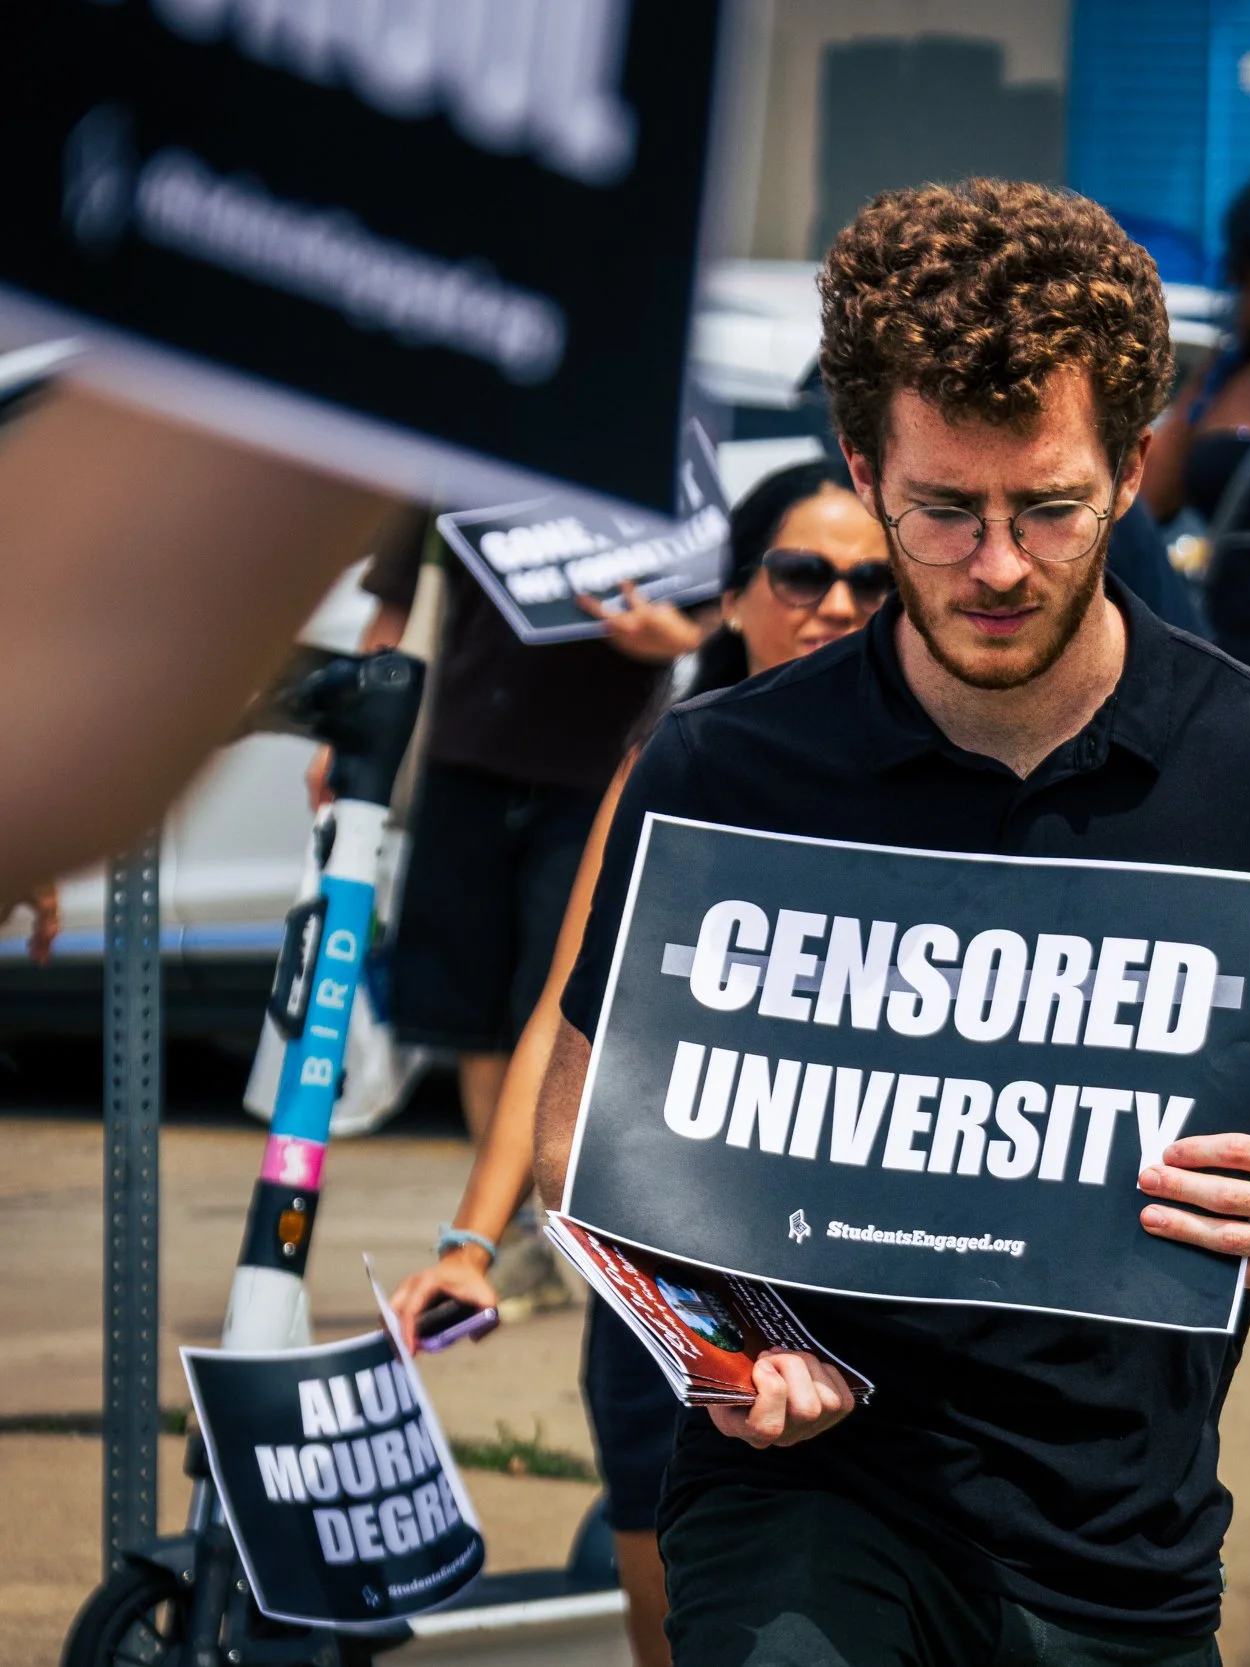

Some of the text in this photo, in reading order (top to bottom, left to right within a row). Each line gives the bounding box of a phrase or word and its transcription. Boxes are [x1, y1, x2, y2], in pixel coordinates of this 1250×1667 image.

[300, 929, 358, 1088] BIRD
[688, 897, 1221, 1056] CENSORED
[662, 1038, 1196, 1191] UNIVERSITY
[584, 1230, 698, 1360] Rest In Peace
[826, 1219, 1027, 1259] StudentsEngaged.org
